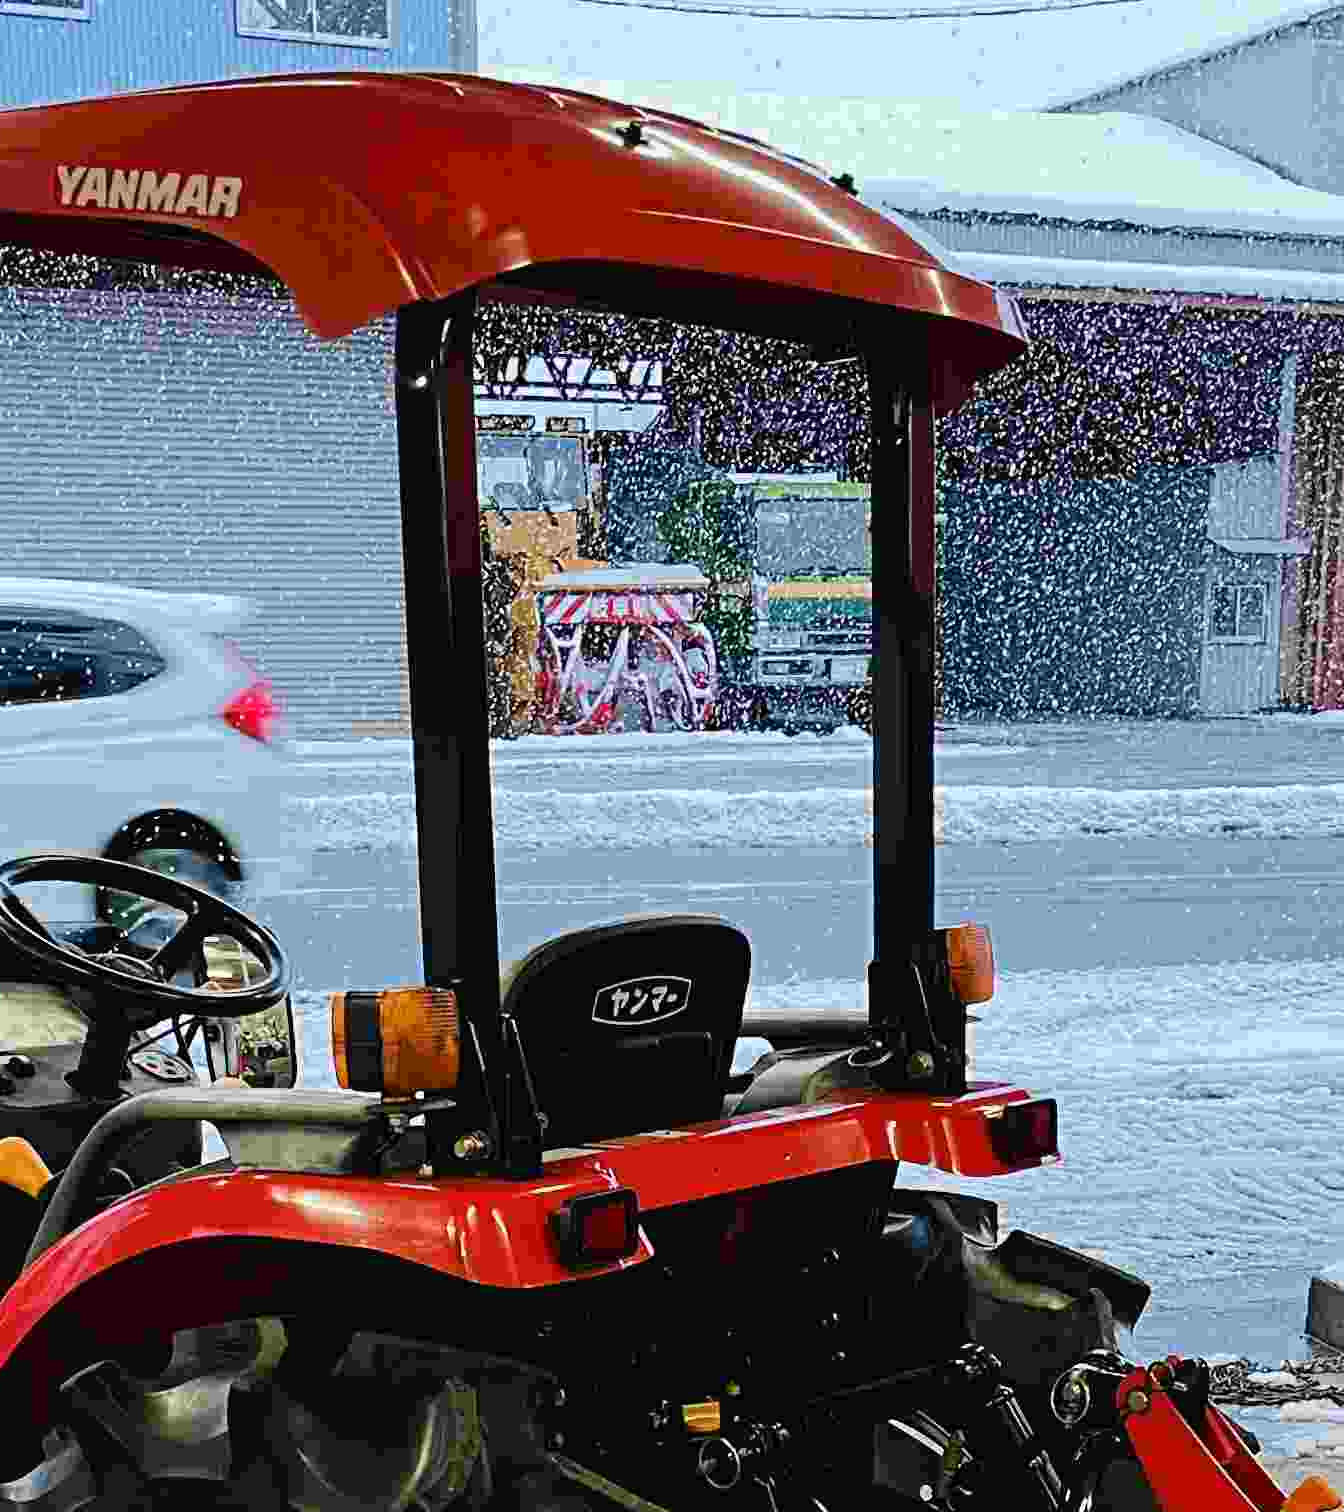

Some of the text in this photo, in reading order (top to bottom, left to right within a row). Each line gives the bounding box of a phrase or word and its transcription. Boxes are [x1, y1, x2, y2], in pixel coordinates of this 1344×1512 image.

[57, 164, 242, 217] YANMAR
[611, 984, 678, 1017] ヤンマー
